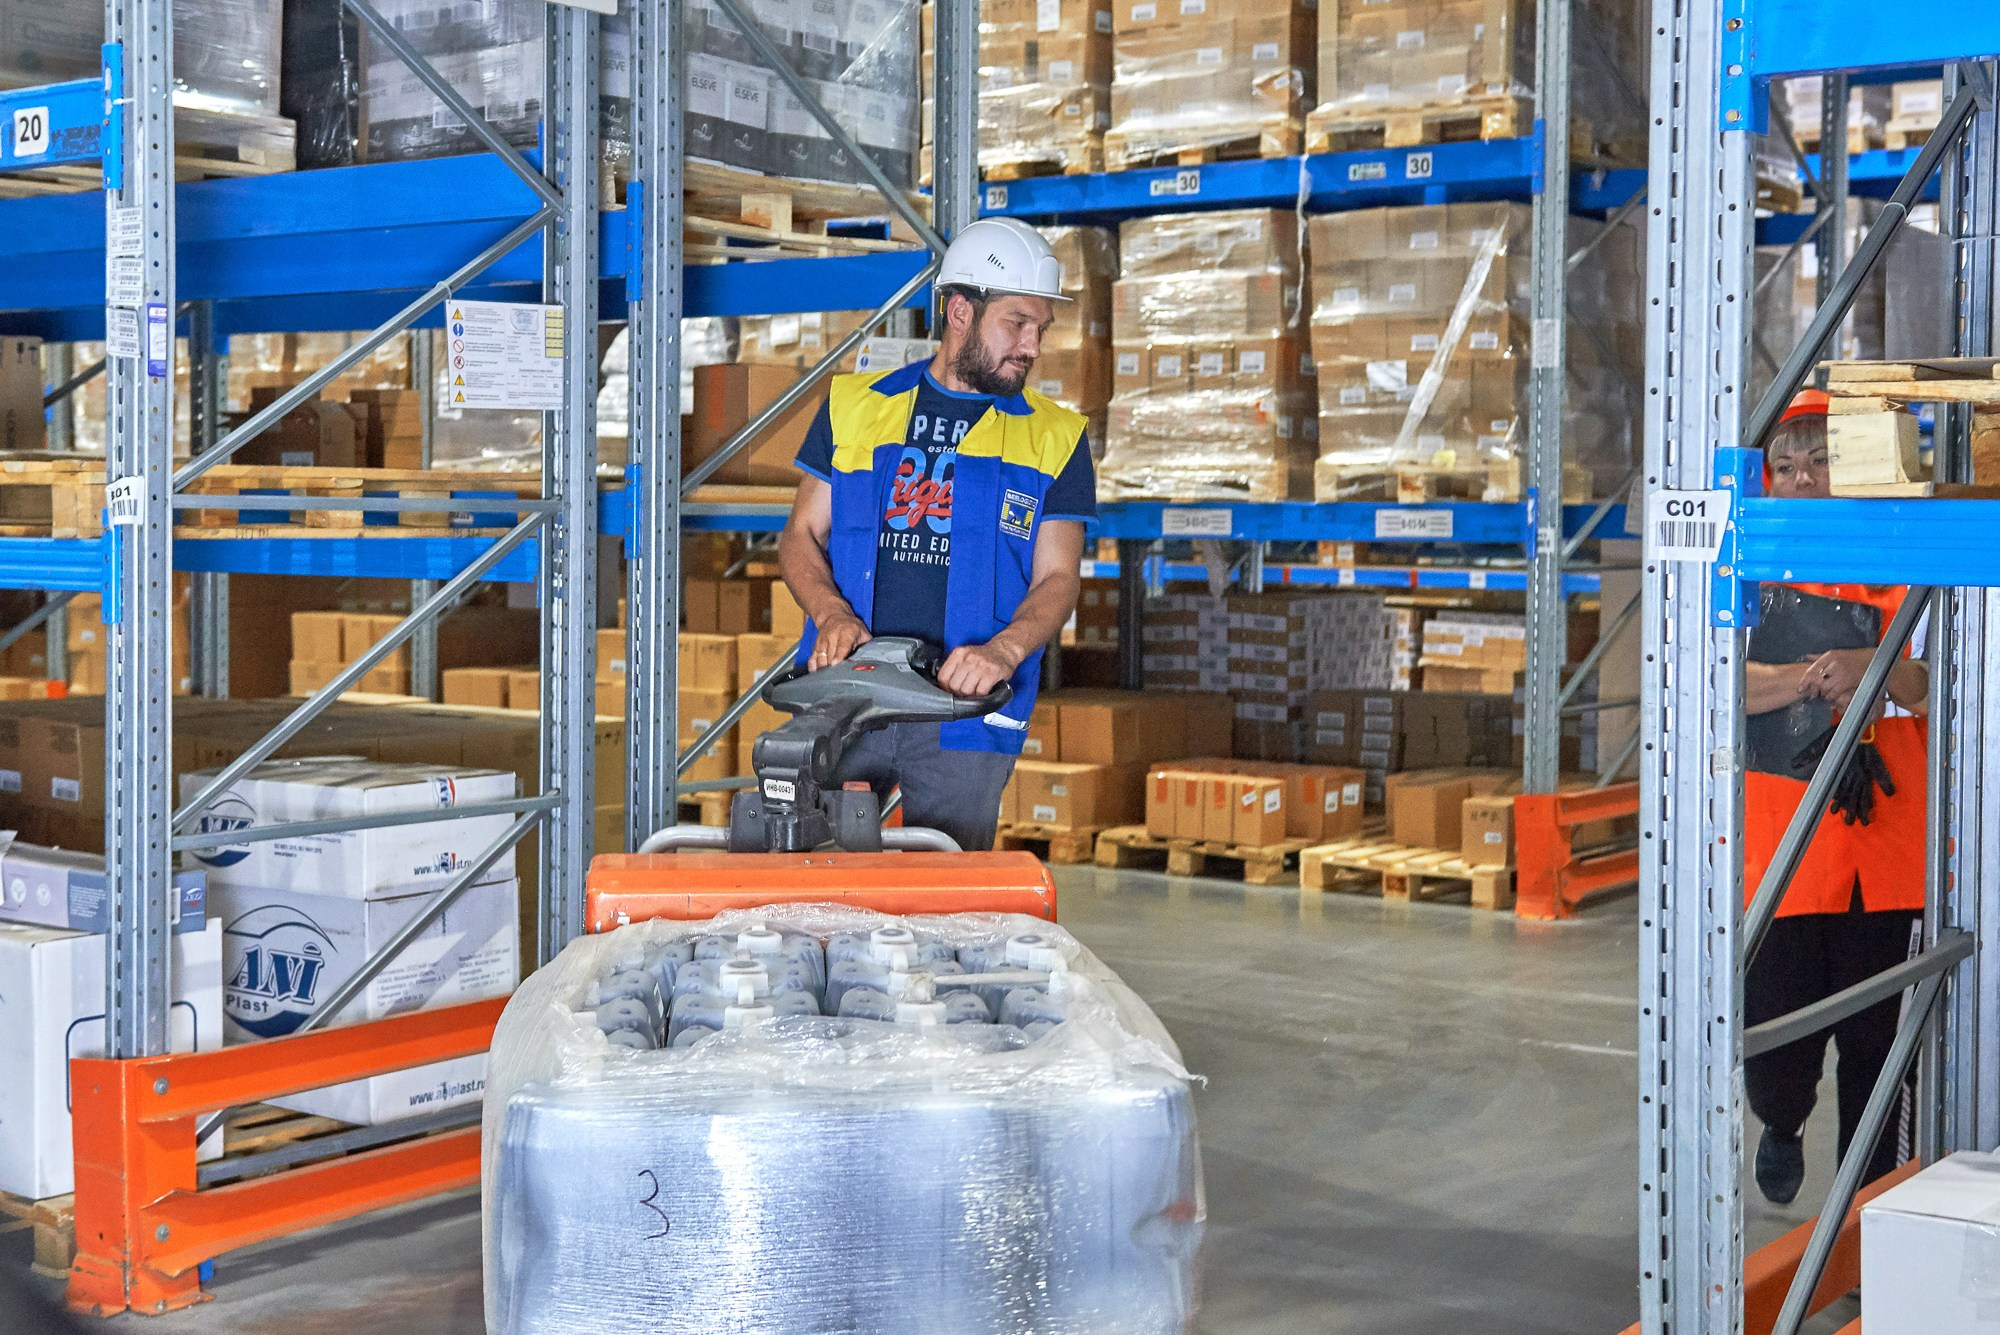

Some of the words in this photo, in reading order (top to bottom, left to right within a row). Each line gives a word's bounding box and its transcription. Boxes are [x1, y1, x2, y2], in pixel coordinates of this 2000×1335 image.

[691, 77, 718, 92] ELSEVE
[734, 87, 760, 103] ELSEVE
[20, 114, 42, 142] 20
[1410, 157, 1430, 175] 30
[1179, 175, 1198, 191] 30
[989, 190, 1007, 206] 30
[1666, 499, 1706, 517] C01
[892, 551, 951, 567] AUTHENTIC
[226, 994, 269, 1013] Plast
[637, 1169, 671, 1241] 3
